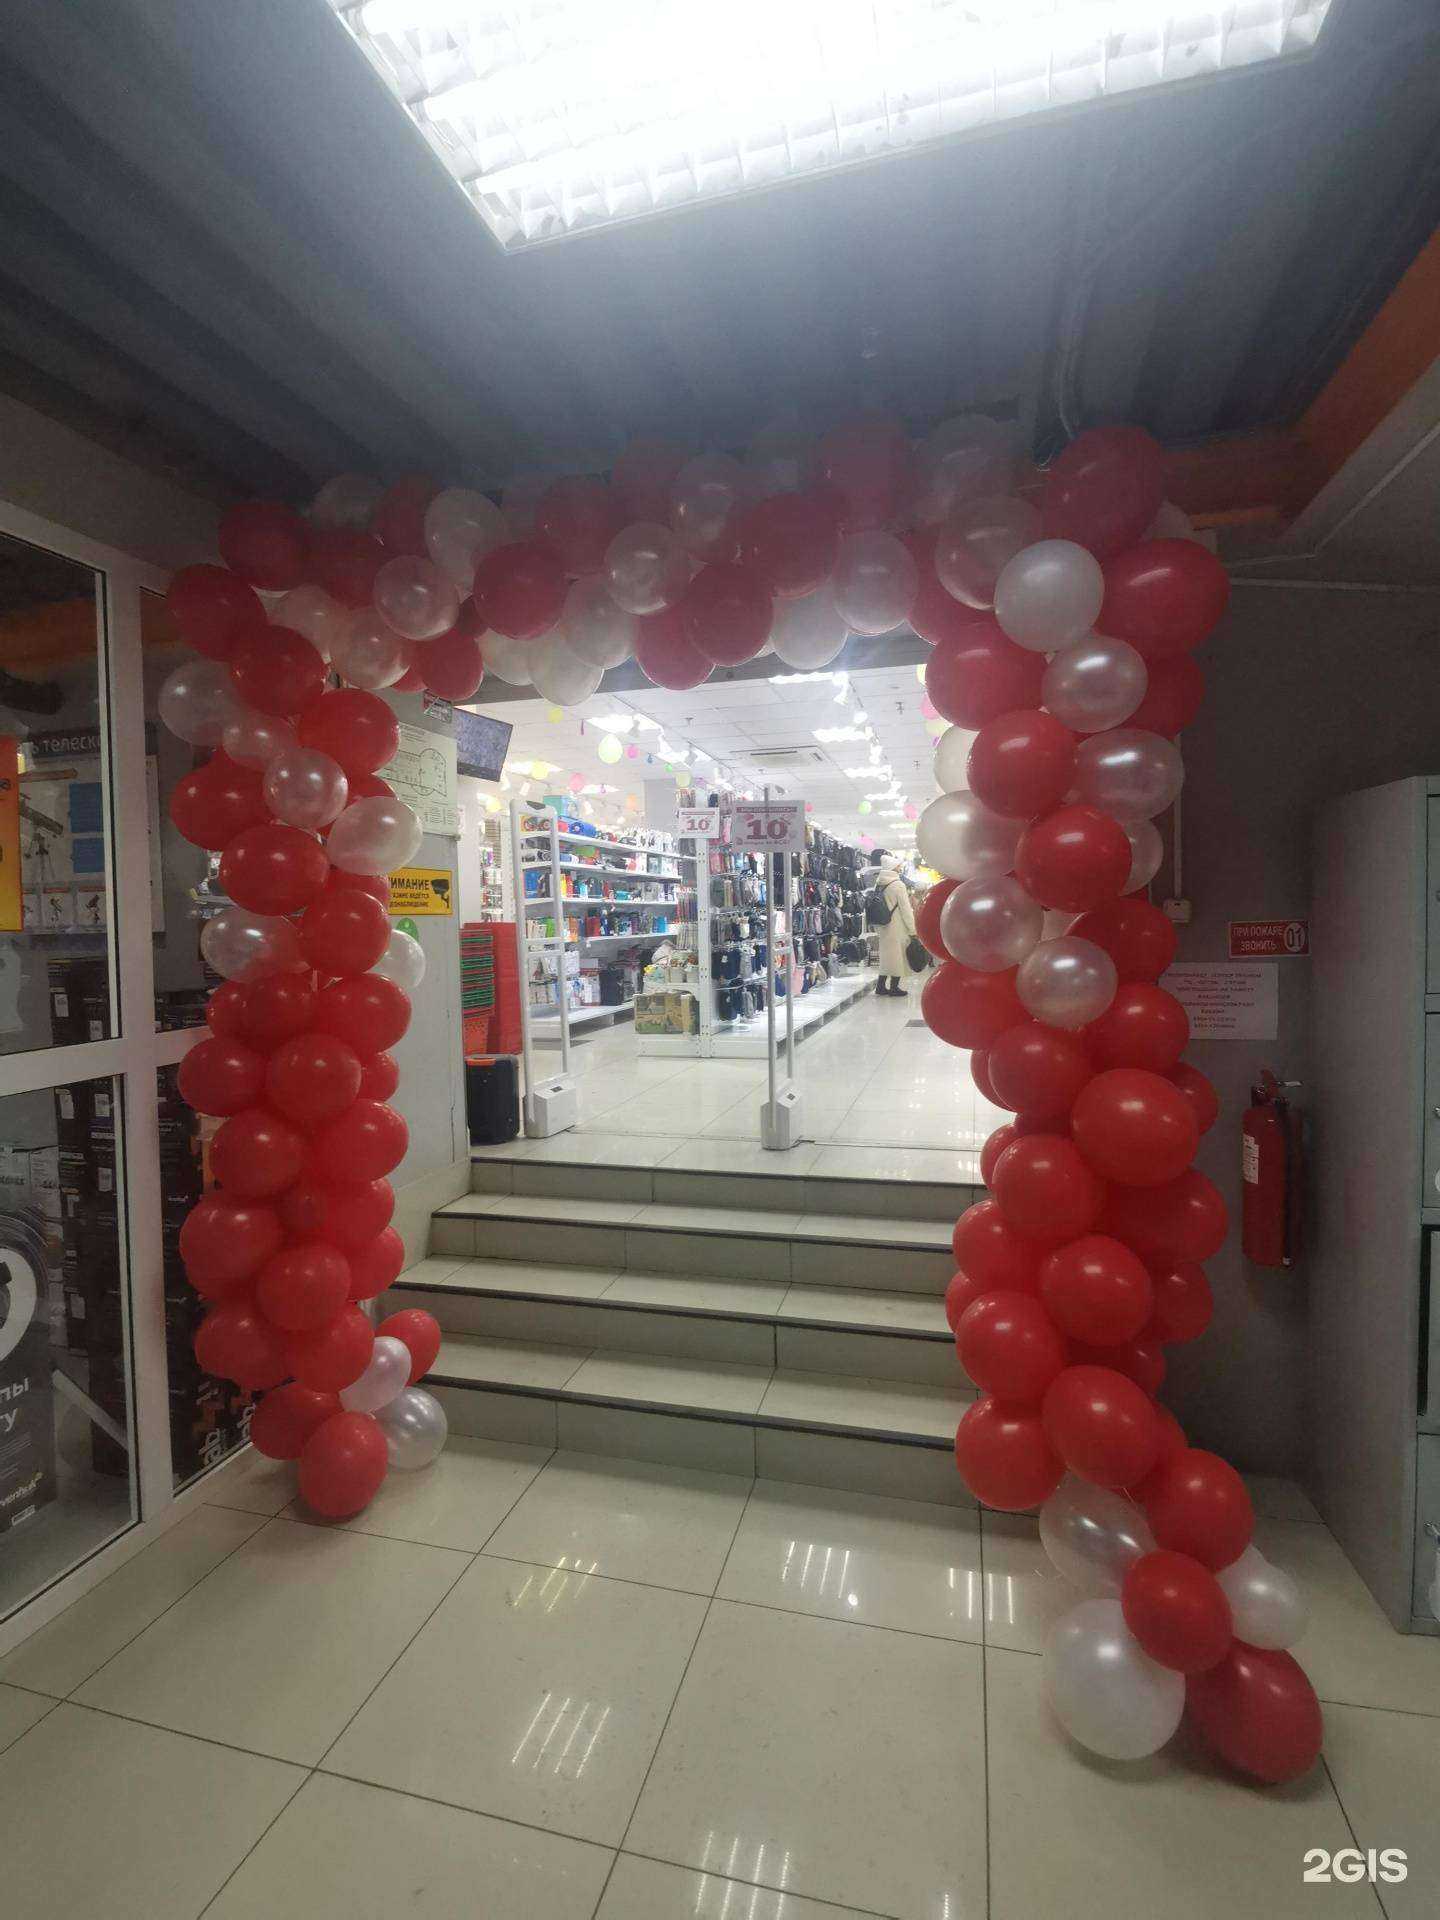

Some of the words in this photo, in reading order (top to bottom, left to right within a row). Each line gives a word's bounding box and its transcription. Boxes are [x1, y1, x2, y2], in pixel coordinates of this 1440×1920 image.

[42, 736, 100, 752] телеск
[686, 818, 710, 831] 10
[746, 819, 788, 840] 10
[1239, 940, 1279, 952] ЗВОНИТЬ
